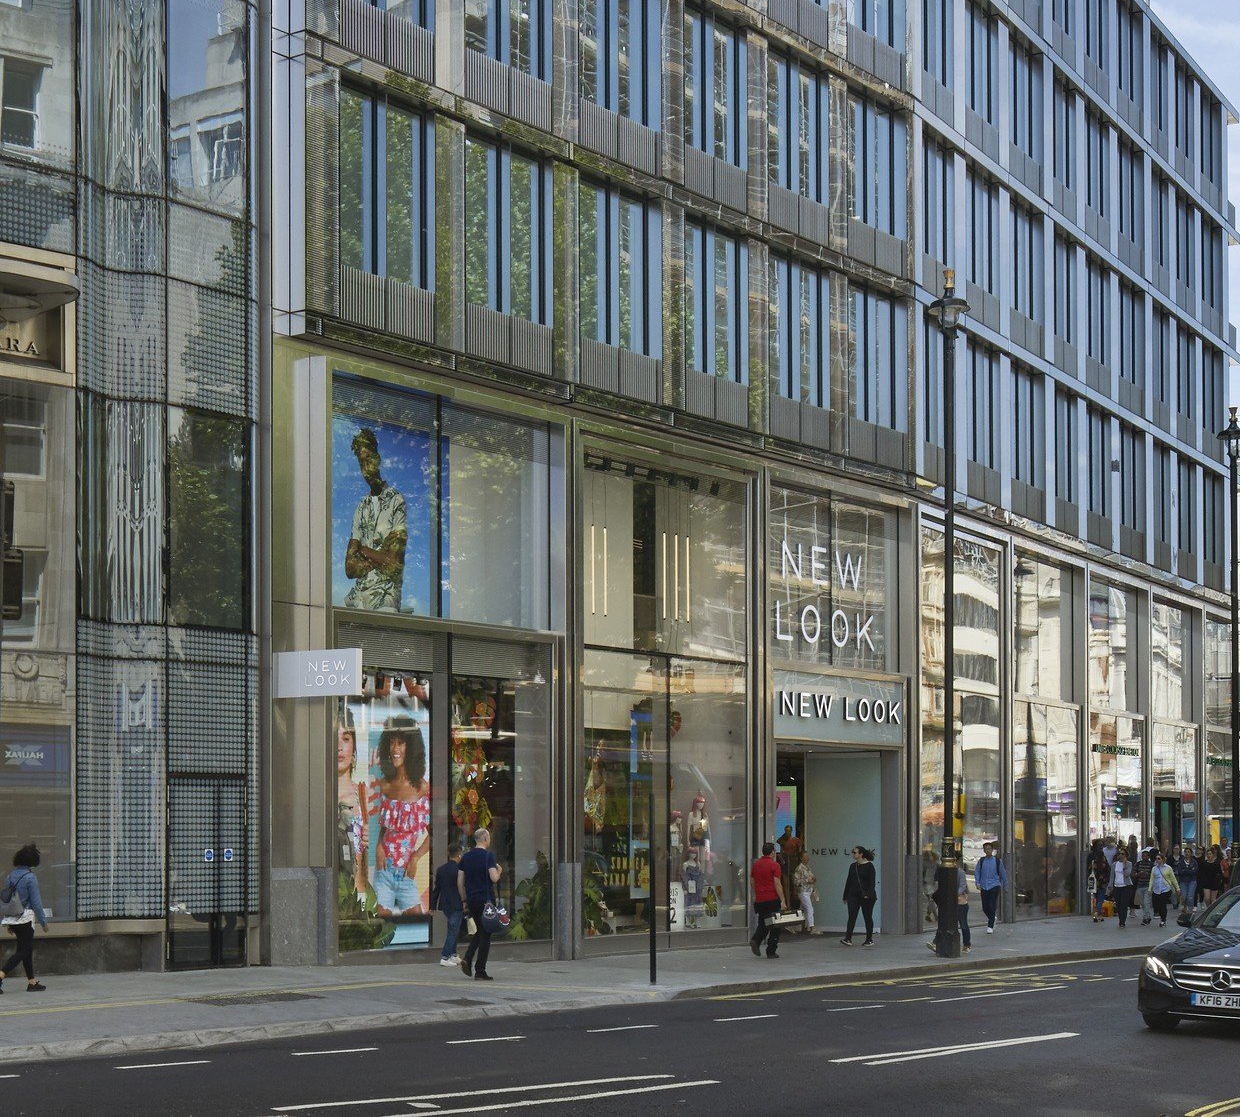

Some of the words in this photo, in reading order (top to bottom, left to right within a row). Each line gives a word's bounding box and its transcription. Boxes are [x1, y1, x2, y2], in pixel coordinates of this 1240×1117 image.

[781, 540, 862, 592] NEW
[776, 600, 875, 652] LOOK
[308, 659, 347, 672] NEW
[304, 674, 351, 687] LOOK
[779, 690, 833, 719] NEW
[843, 696, 901, 724] LOOK
[812, 848, 838, 856] NEW
[1200, 995, 1222, 1006] KF16
